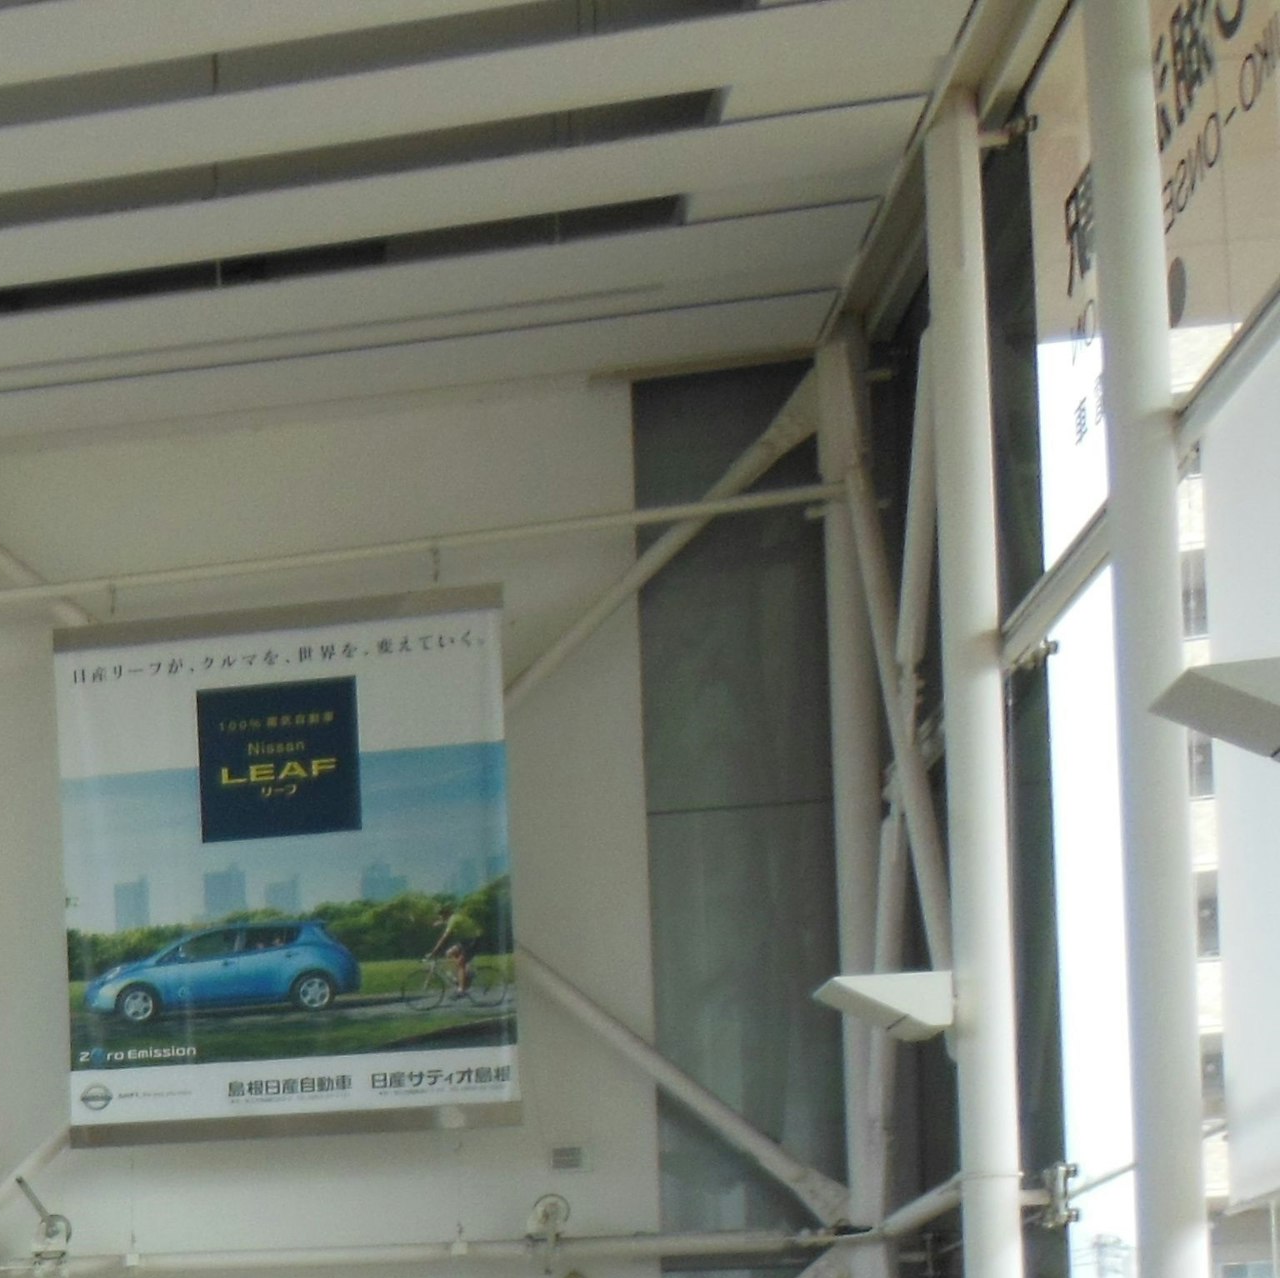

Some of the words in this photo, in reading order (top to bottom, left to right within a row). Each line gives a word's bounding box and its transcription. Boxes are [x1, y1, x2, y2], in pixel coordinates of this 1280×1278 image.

[248, 741, 305, 756] Nissan
[220, 758, 337, 785] LEAF
[261, 784, 298, 797] リーフ
[127, 1045, 197, 1060] Emission
